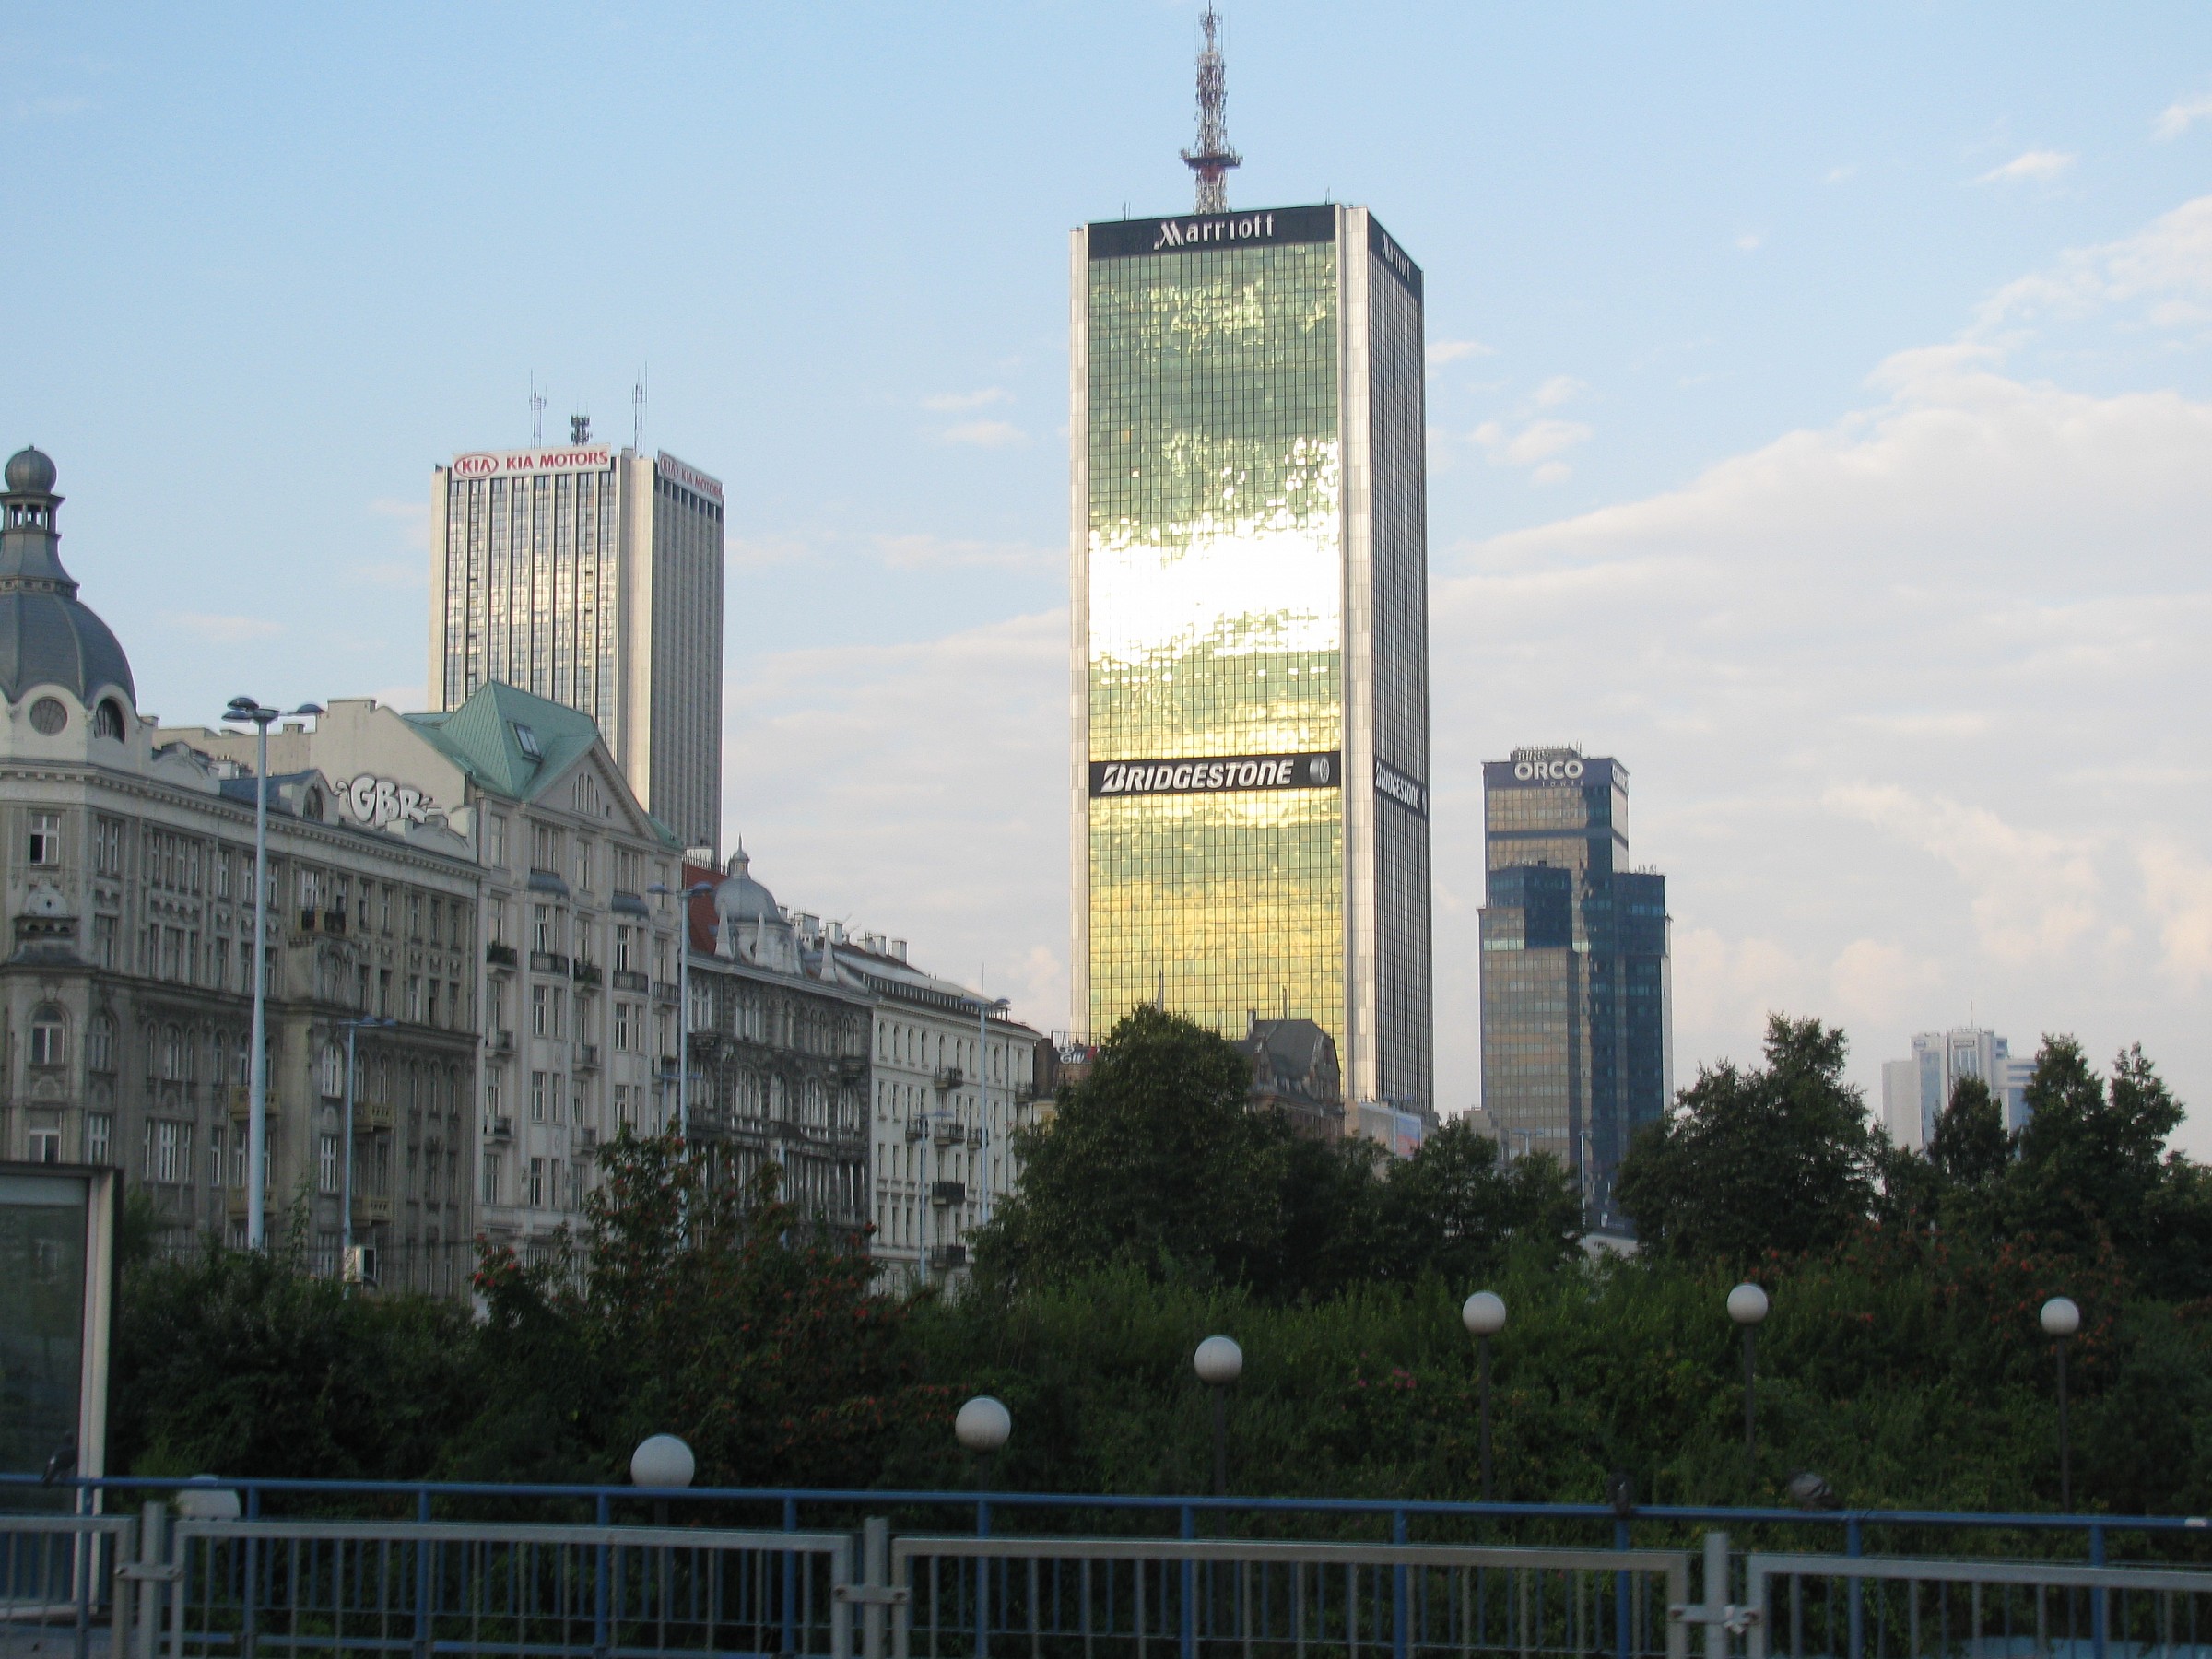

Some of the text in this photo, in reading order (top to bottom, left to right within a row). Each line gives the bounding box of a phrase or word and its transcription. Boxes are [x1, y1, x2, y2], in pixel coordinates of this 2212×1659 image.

[1154, 213, 1274, 250] Marriott
[462, 451, 608, 473] KIA KIA MOTORS
[1100, 759, 1294, 793] BRIDGESTONE
[1514, 760, 1583, 781] ORCO
